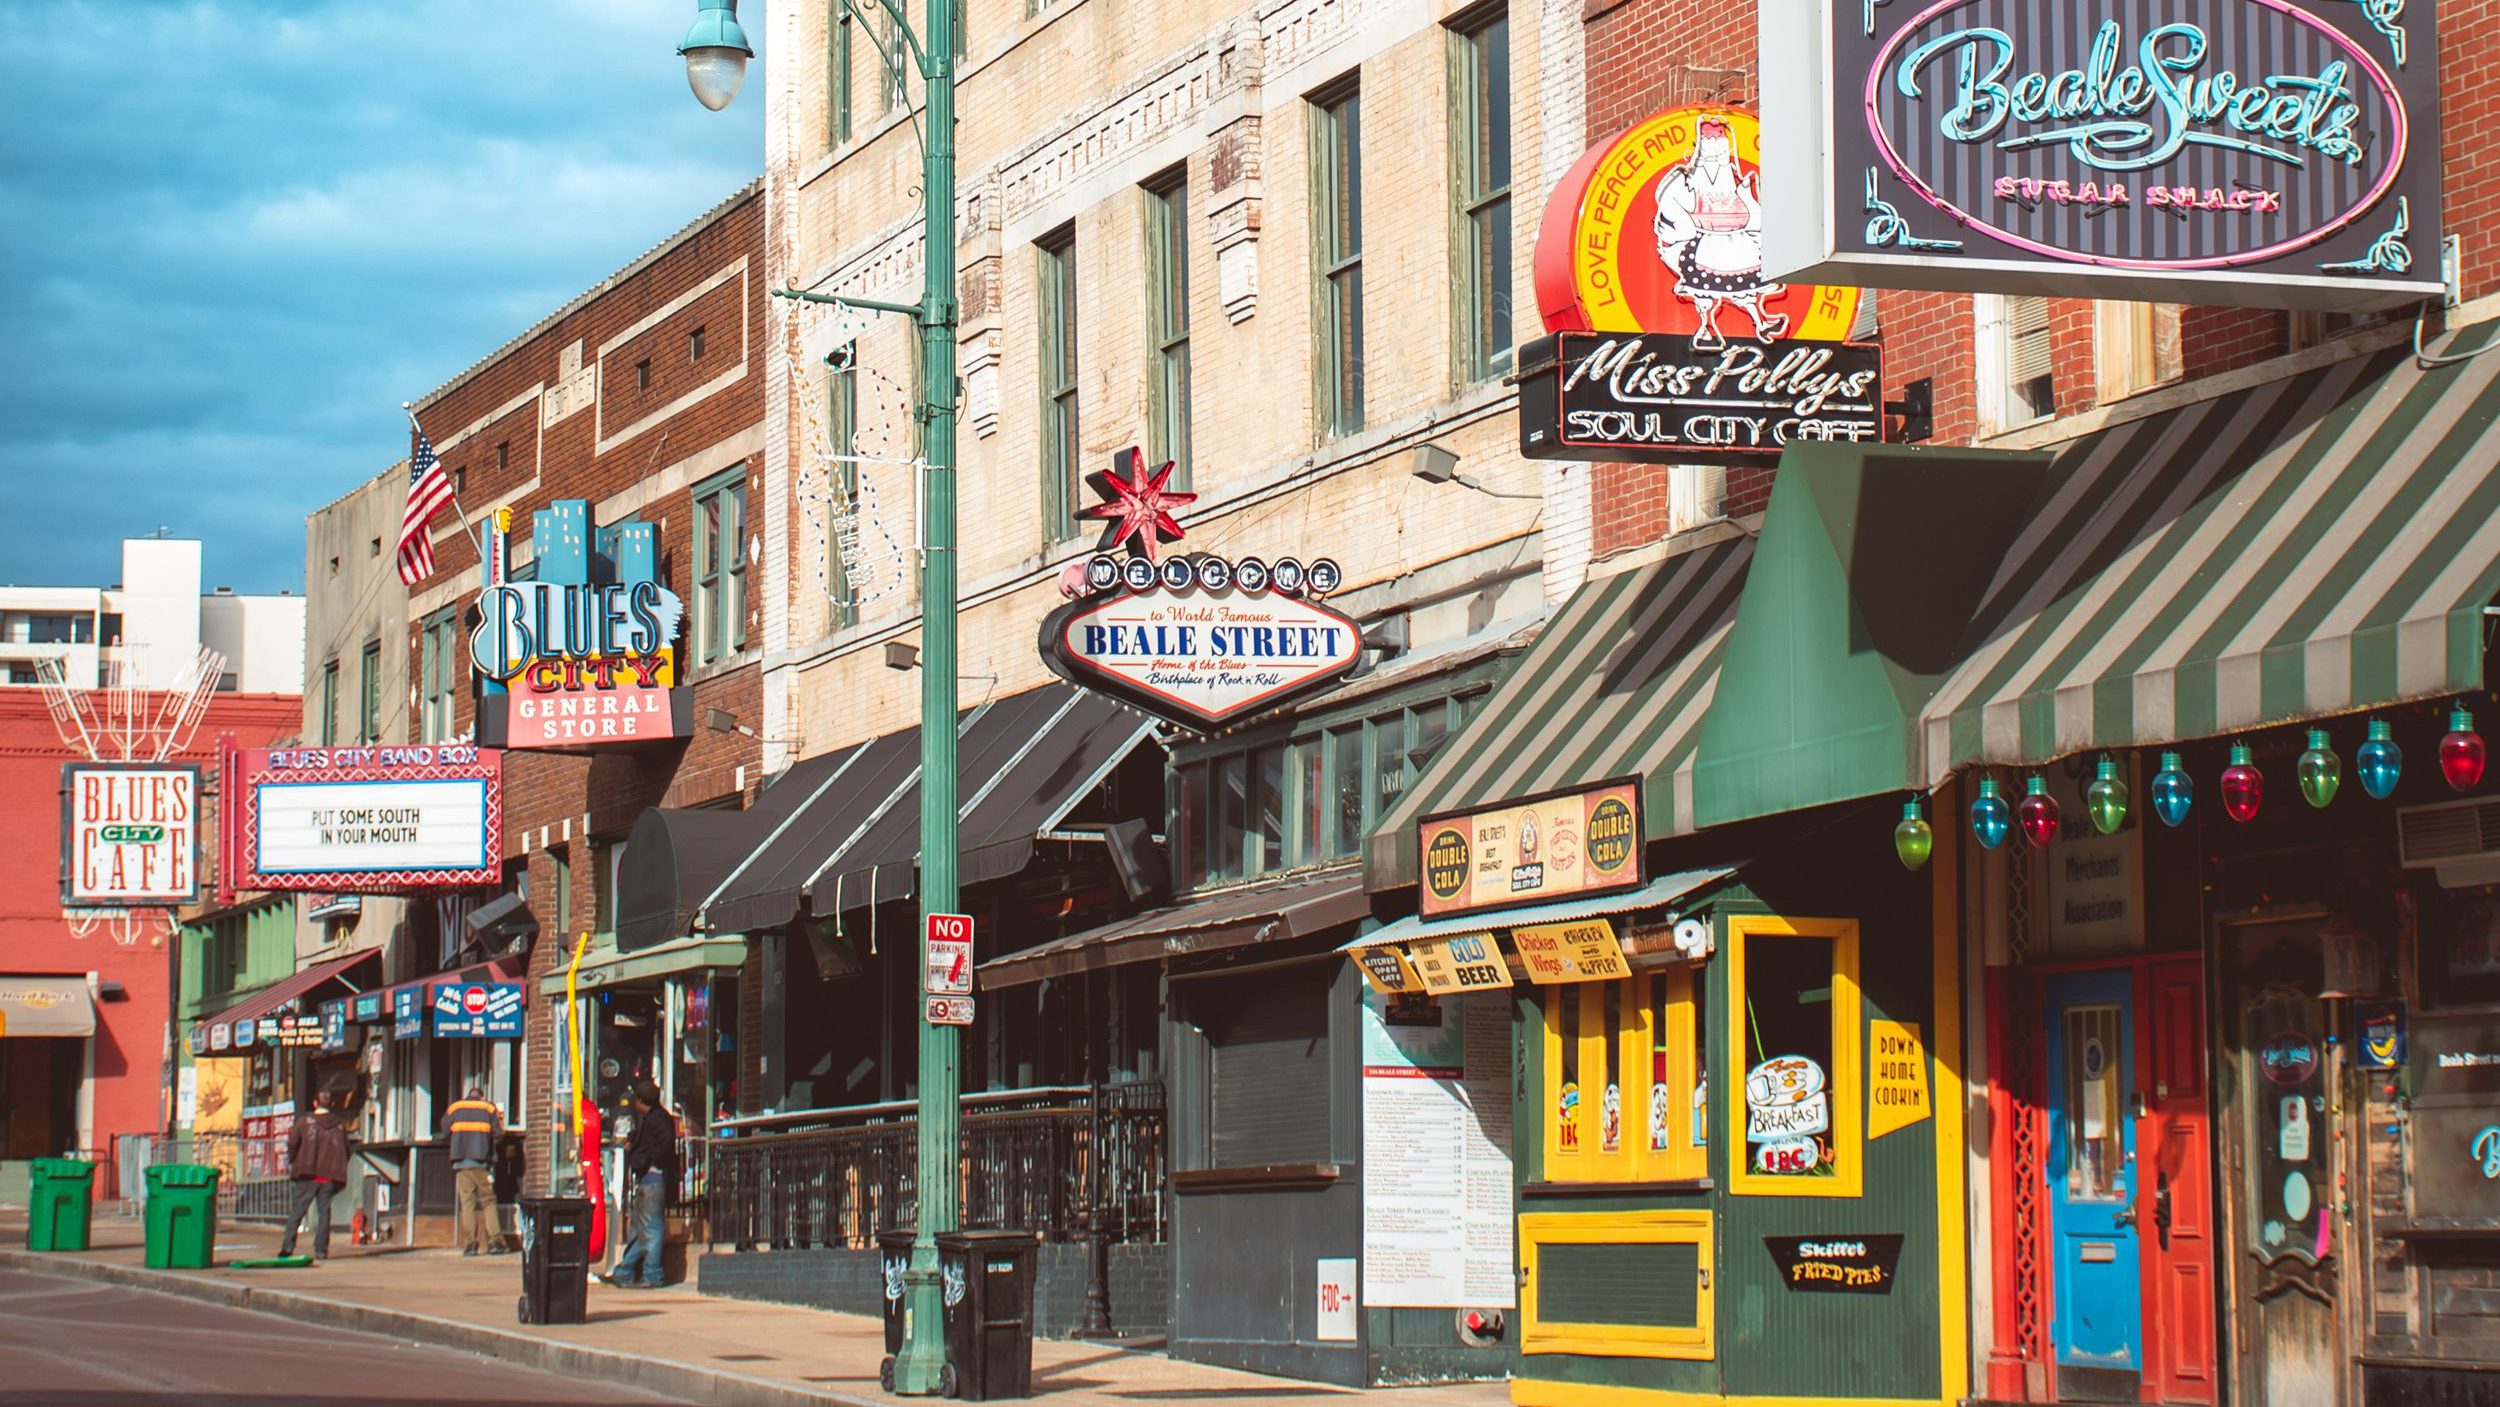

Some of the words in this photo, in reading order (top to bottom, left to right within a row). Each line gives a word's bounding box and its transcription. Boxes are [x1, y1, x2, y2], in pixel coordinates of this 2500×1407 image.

[1899, 19, 2155, 142] Beale
[2135, 22, 2364, 170] Sweets
[1643, 123, 1687, 160] AND
[1593, 151, 1646, 225] PEACE
[1994, 176, 2130, 207] SUGAR
[1588, 229, 1616, 308] LOVE,
[1564, 340, 1706, 398] Miss
[1704, 345, 1876, 415] Pollys
[1567, 411, 1678, 443] SOUL
[1683, 413, 1766, 445] CITY
[1090, 562, 1338, 593] WELCOME
[1150, 610, 1164, 622] to
[1167, 606, 1215, 622] World
[1217, 606, 1273, 623] Famous
[498, 581, 663, 680] BLUES
[1084, 624, 1198, 656] BEALE
[1211, 625, 1341, 657] STREET
[525, 657, 666, 694] CITY
[1151, 658, 1186, 671] Home
[1187, 659, 1198, 671] of
[1198, 658, 1217, 670] the
[1218, 659, 1249, 670] Blues
[1146, 672, 1204, 687] Birthplace
[1205, 674, 1216, 689] of
[1217, 673, 1244, 686] Rock
[1254, 674, 1284, 686] Roll
[519, 695, 660, 719] GENERAL
[543, 717, 637, 739] STORE
[268, 749, 329, 769] BLUES
[334, 748, 376, 767] CITY
[380, 747, 433, 767] BAND
[438, 746, 479, 765] BOX
[83, 776, 188, 823] BLUES
[312, 810, 335, 826] PUT
[340, 809, 374, 825] SOME
[379, 808, 420, 824] SOUTH
[1591, 815, 1631, 840] DOUBLE
[103, 826, 163, 841] CITY
[321, 829, 332, 844] IN
[337, 829, 366, 844] YOUR
[371, 828, 417, 843] MOUTH
[83, 828, 187, 891] CAFE
[1429, 845, 1467, 868] DOUBLE
[1597, 844, 1624, 863] COLA
[1434, 871, 1460, 890] COLA
[936, 919, 964, 938] NO
[1563, 927, 1605, 946] CHICKEN
[930, 943, 966, 955] PARKING
[1449, 937, 1486, 963] COLD
[1517, 933, 1559, 952] Chicken
[1364, 957, 1397, 968] KITCHEN
[1374, 965, 1398, 976] OPEN
[1531, 955, 1563, 976] Wings
[1455, 965, 1501, 986] BEER
[466, 993, 488, 1006] STOP
[1880, 1036, 1915, 1056] DOWN
[1880, 1061, 1916, 1081] HOME
[1875, 1086, 1924, 1107] COOKIN'
[1751, 1103, 1822, 1134] BREAKFAST
[1561, 1122, 1578, 1146] IBC
[1765, 1147, 1806, 1172] IBC
[1798, 1240, 1867, 1258] Skillet
[1792, 1261, 1844, 1281] FRIED
[1844, 1264, 1882, 1286] PIES
[1322, 1284, 1340, 1313] FDC
